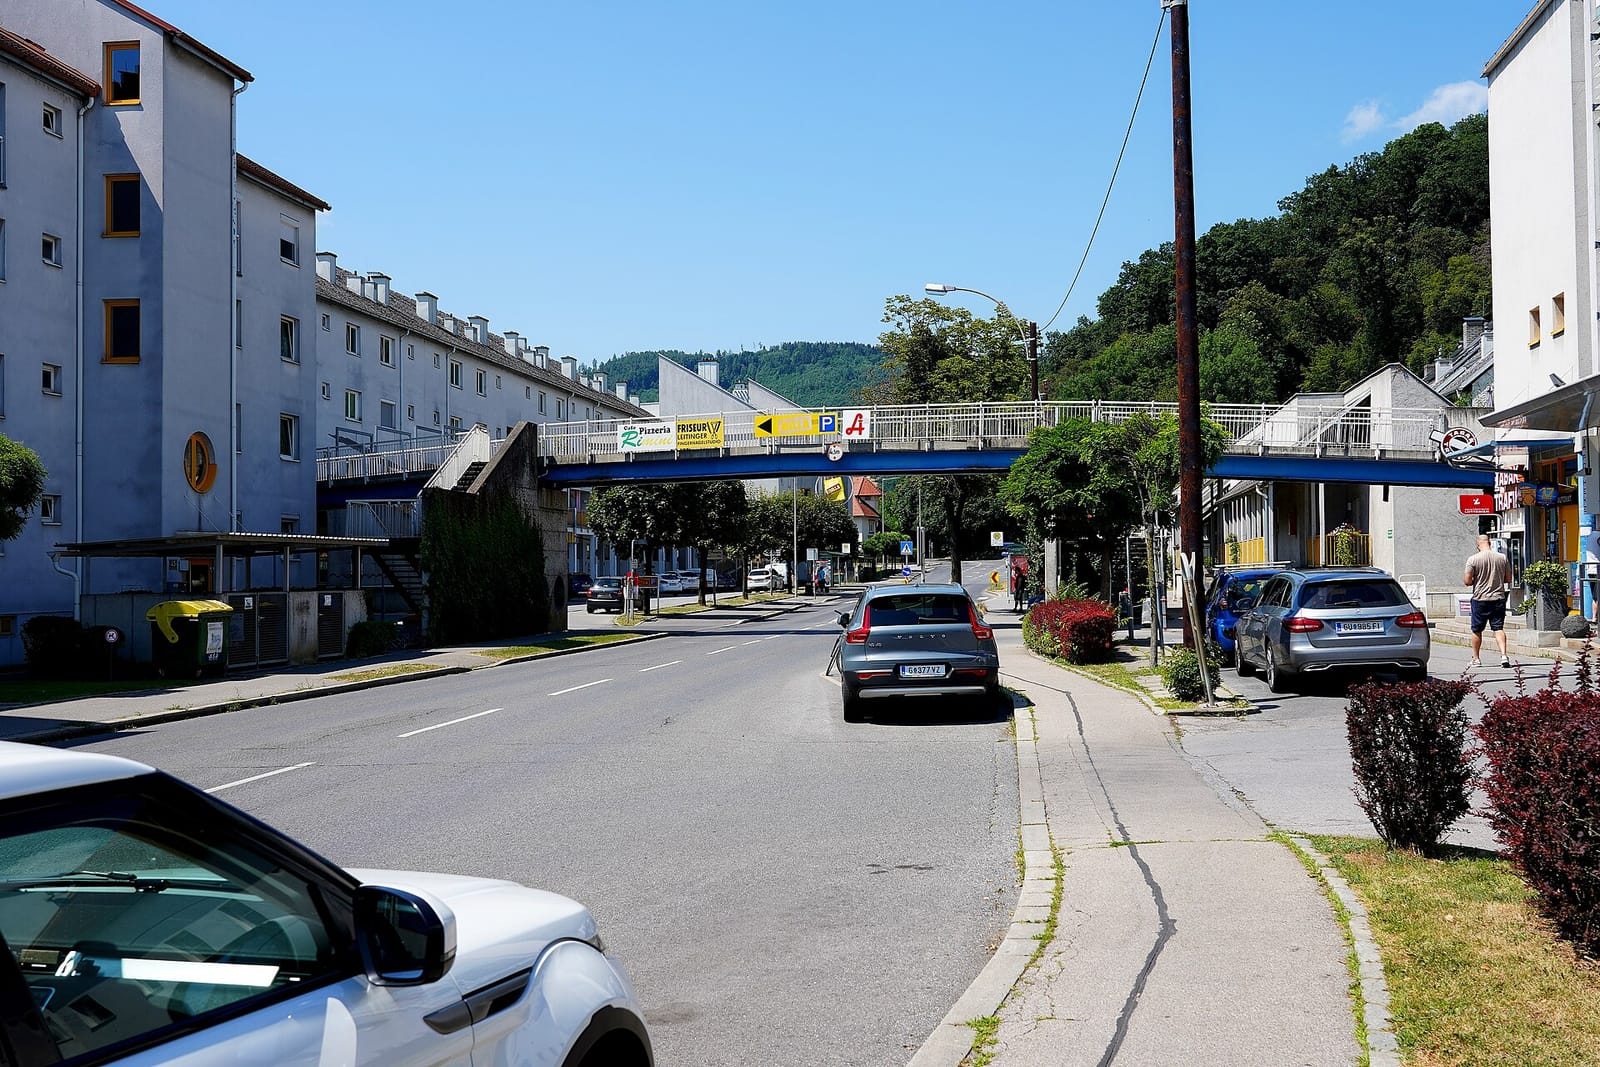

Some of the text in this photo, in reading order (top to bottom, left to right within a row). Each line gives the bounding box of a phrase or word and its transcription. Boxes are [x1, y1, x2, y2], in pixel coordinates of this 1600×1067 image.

[677, 422, 707, 433] FRISEUR
[822, 416, 833, 431] P
[639, 425, 671, 435] Pizzeria
[677, 432, 707, 441] LEITINGER
